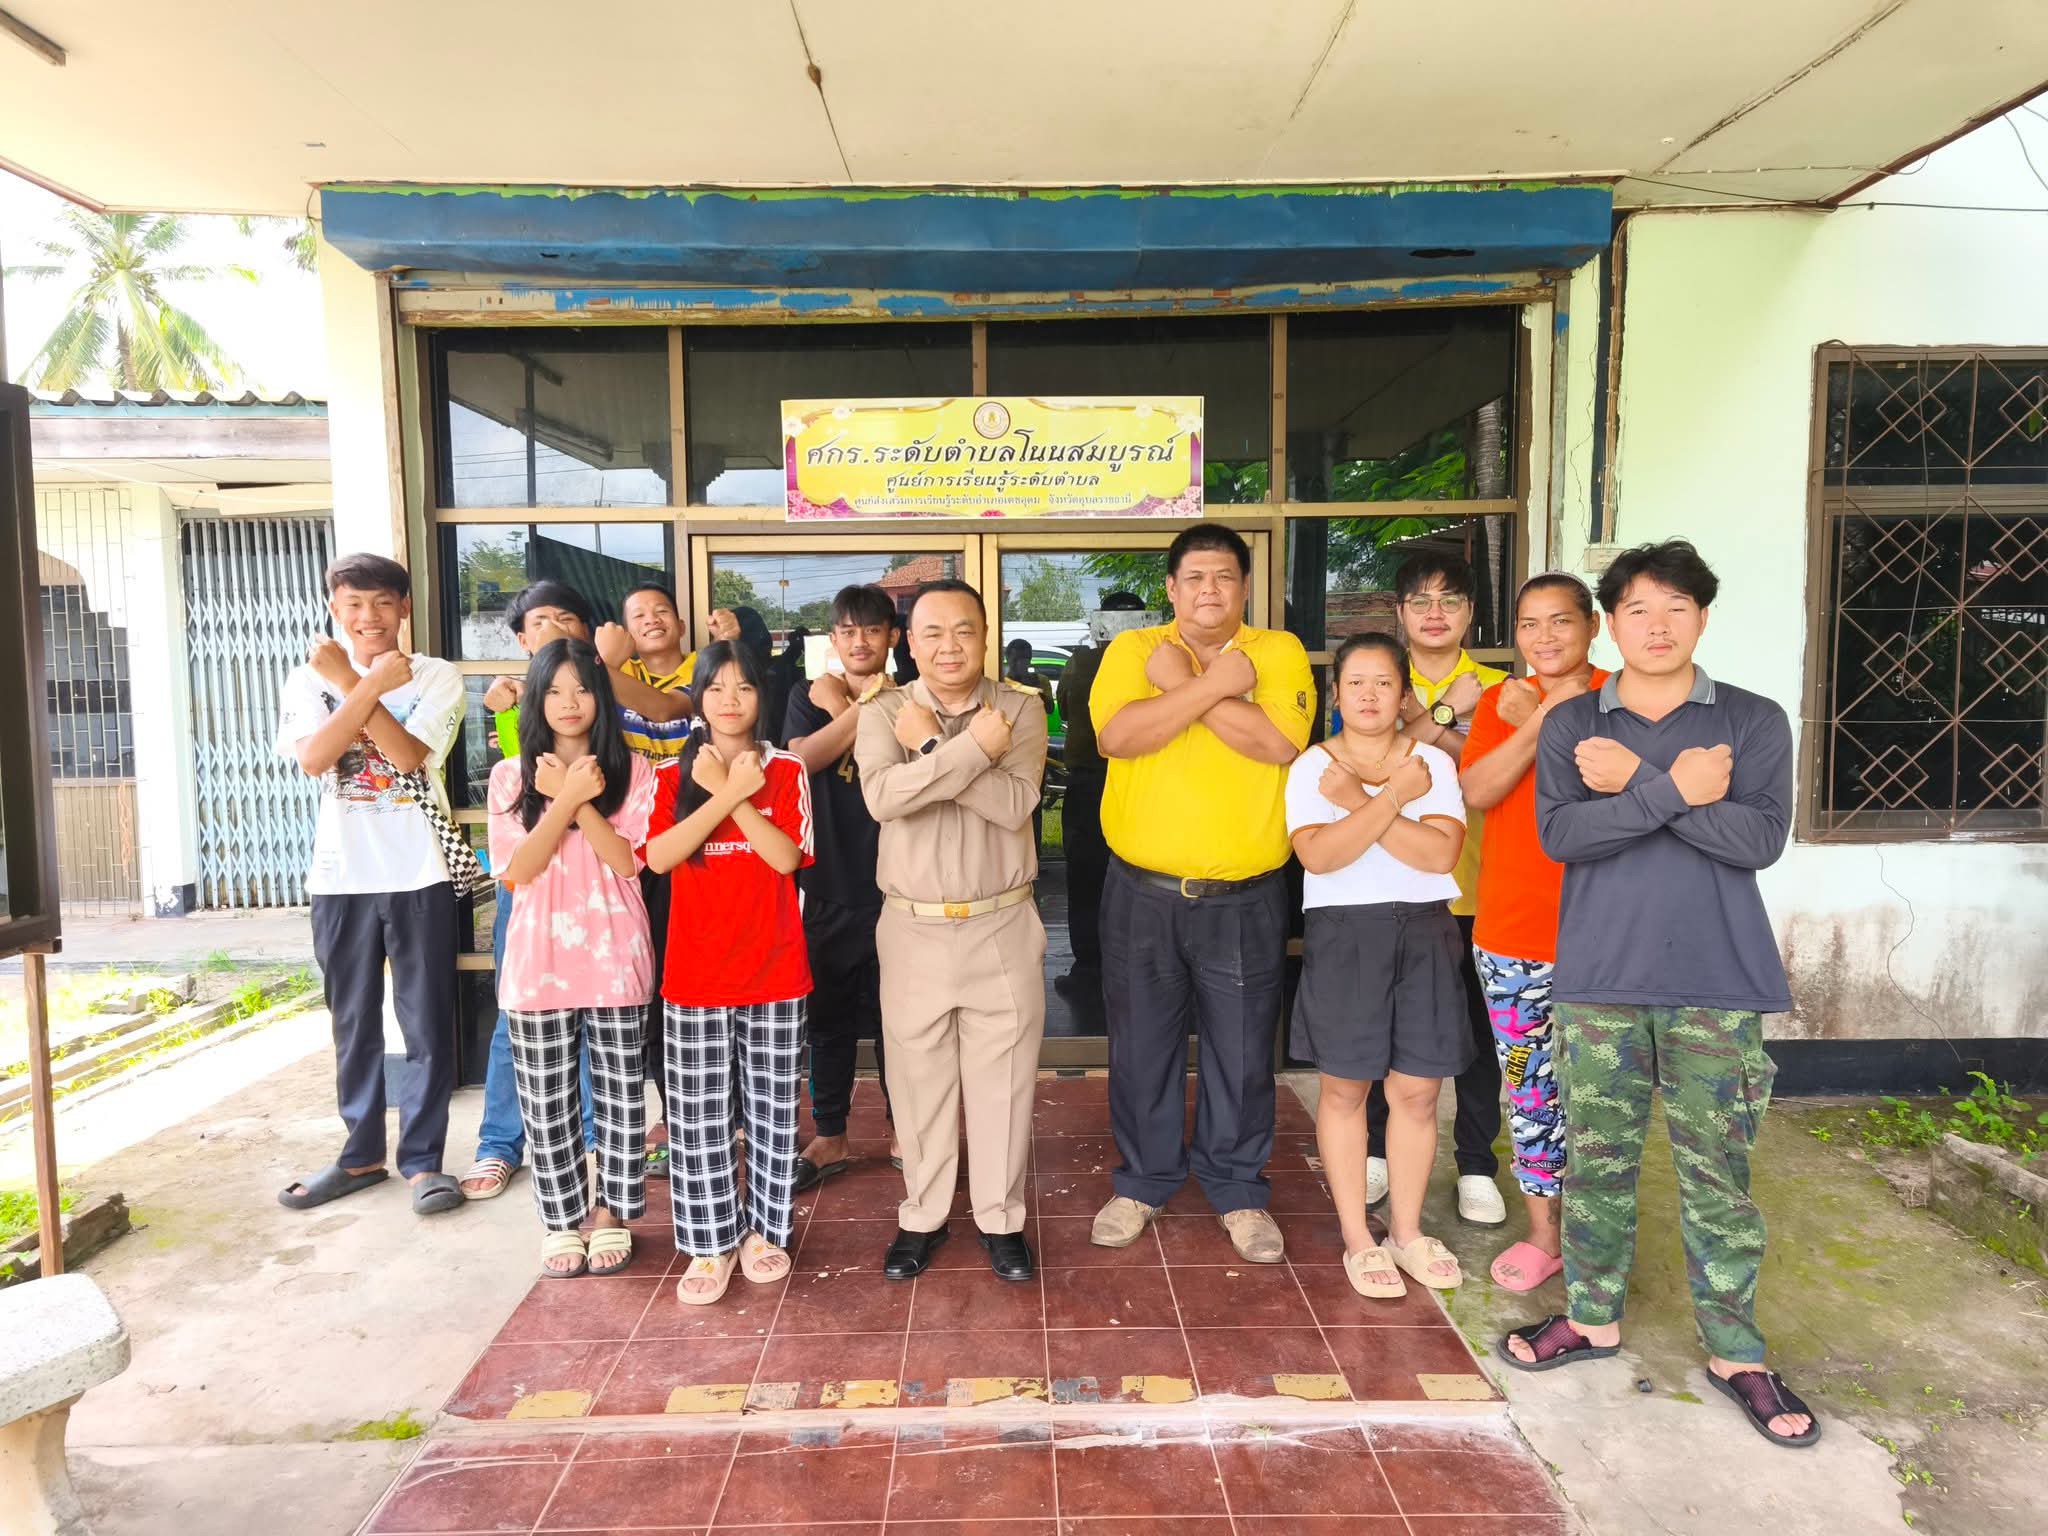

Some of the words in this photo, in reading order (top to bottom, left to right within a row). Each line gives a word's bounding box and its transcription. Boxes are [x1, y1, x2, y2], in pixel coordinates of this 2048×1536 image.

[807, 429, 1184, 472] ศกร.ระดับตำบลโนนสมบูรณ์
[887, 468, 1100, 493] ศูนย์การเรียนรู้ระดับตำบล
[704, 841, 752, 853] nnersq
